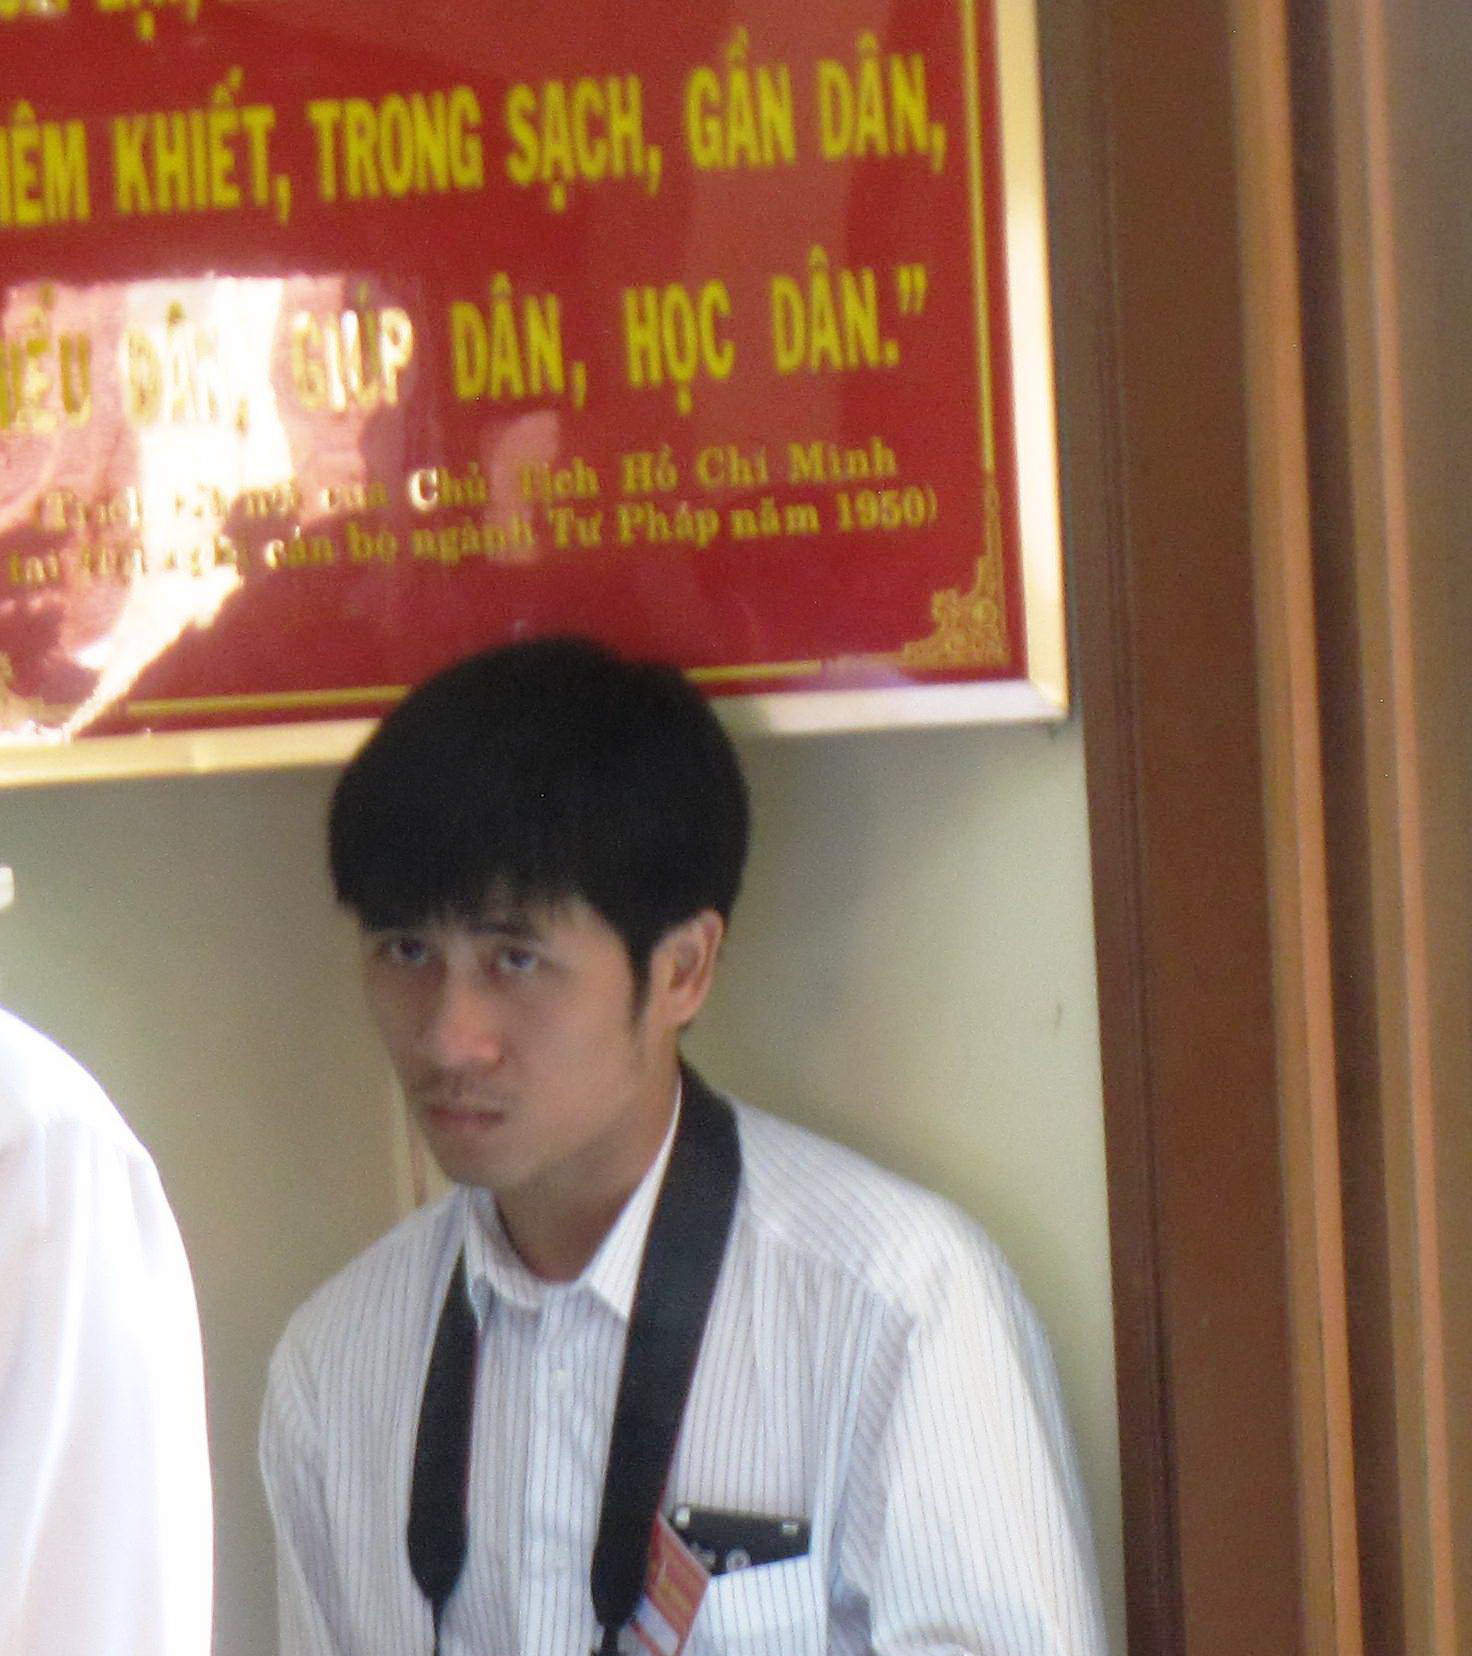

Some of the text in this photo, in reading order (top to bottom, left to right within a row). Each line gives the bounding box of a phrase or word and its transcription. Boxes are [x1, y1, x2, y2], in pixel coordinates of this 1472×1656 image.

[112, 65, 292, 226] KHIẾT,
[308, 84, 486, 203] TRONG
[506, 74, 662, 213] SẠCH,
[816, 28, 948, 173] DÂN,
[450, 270, 588, 410] DÂN,
[622, 278, 735, 416] HỌC
[693, 442, 770, 491] Chí
[786, 435, 898, 486] Minh
[835, 483, 939, 534] 1950)
